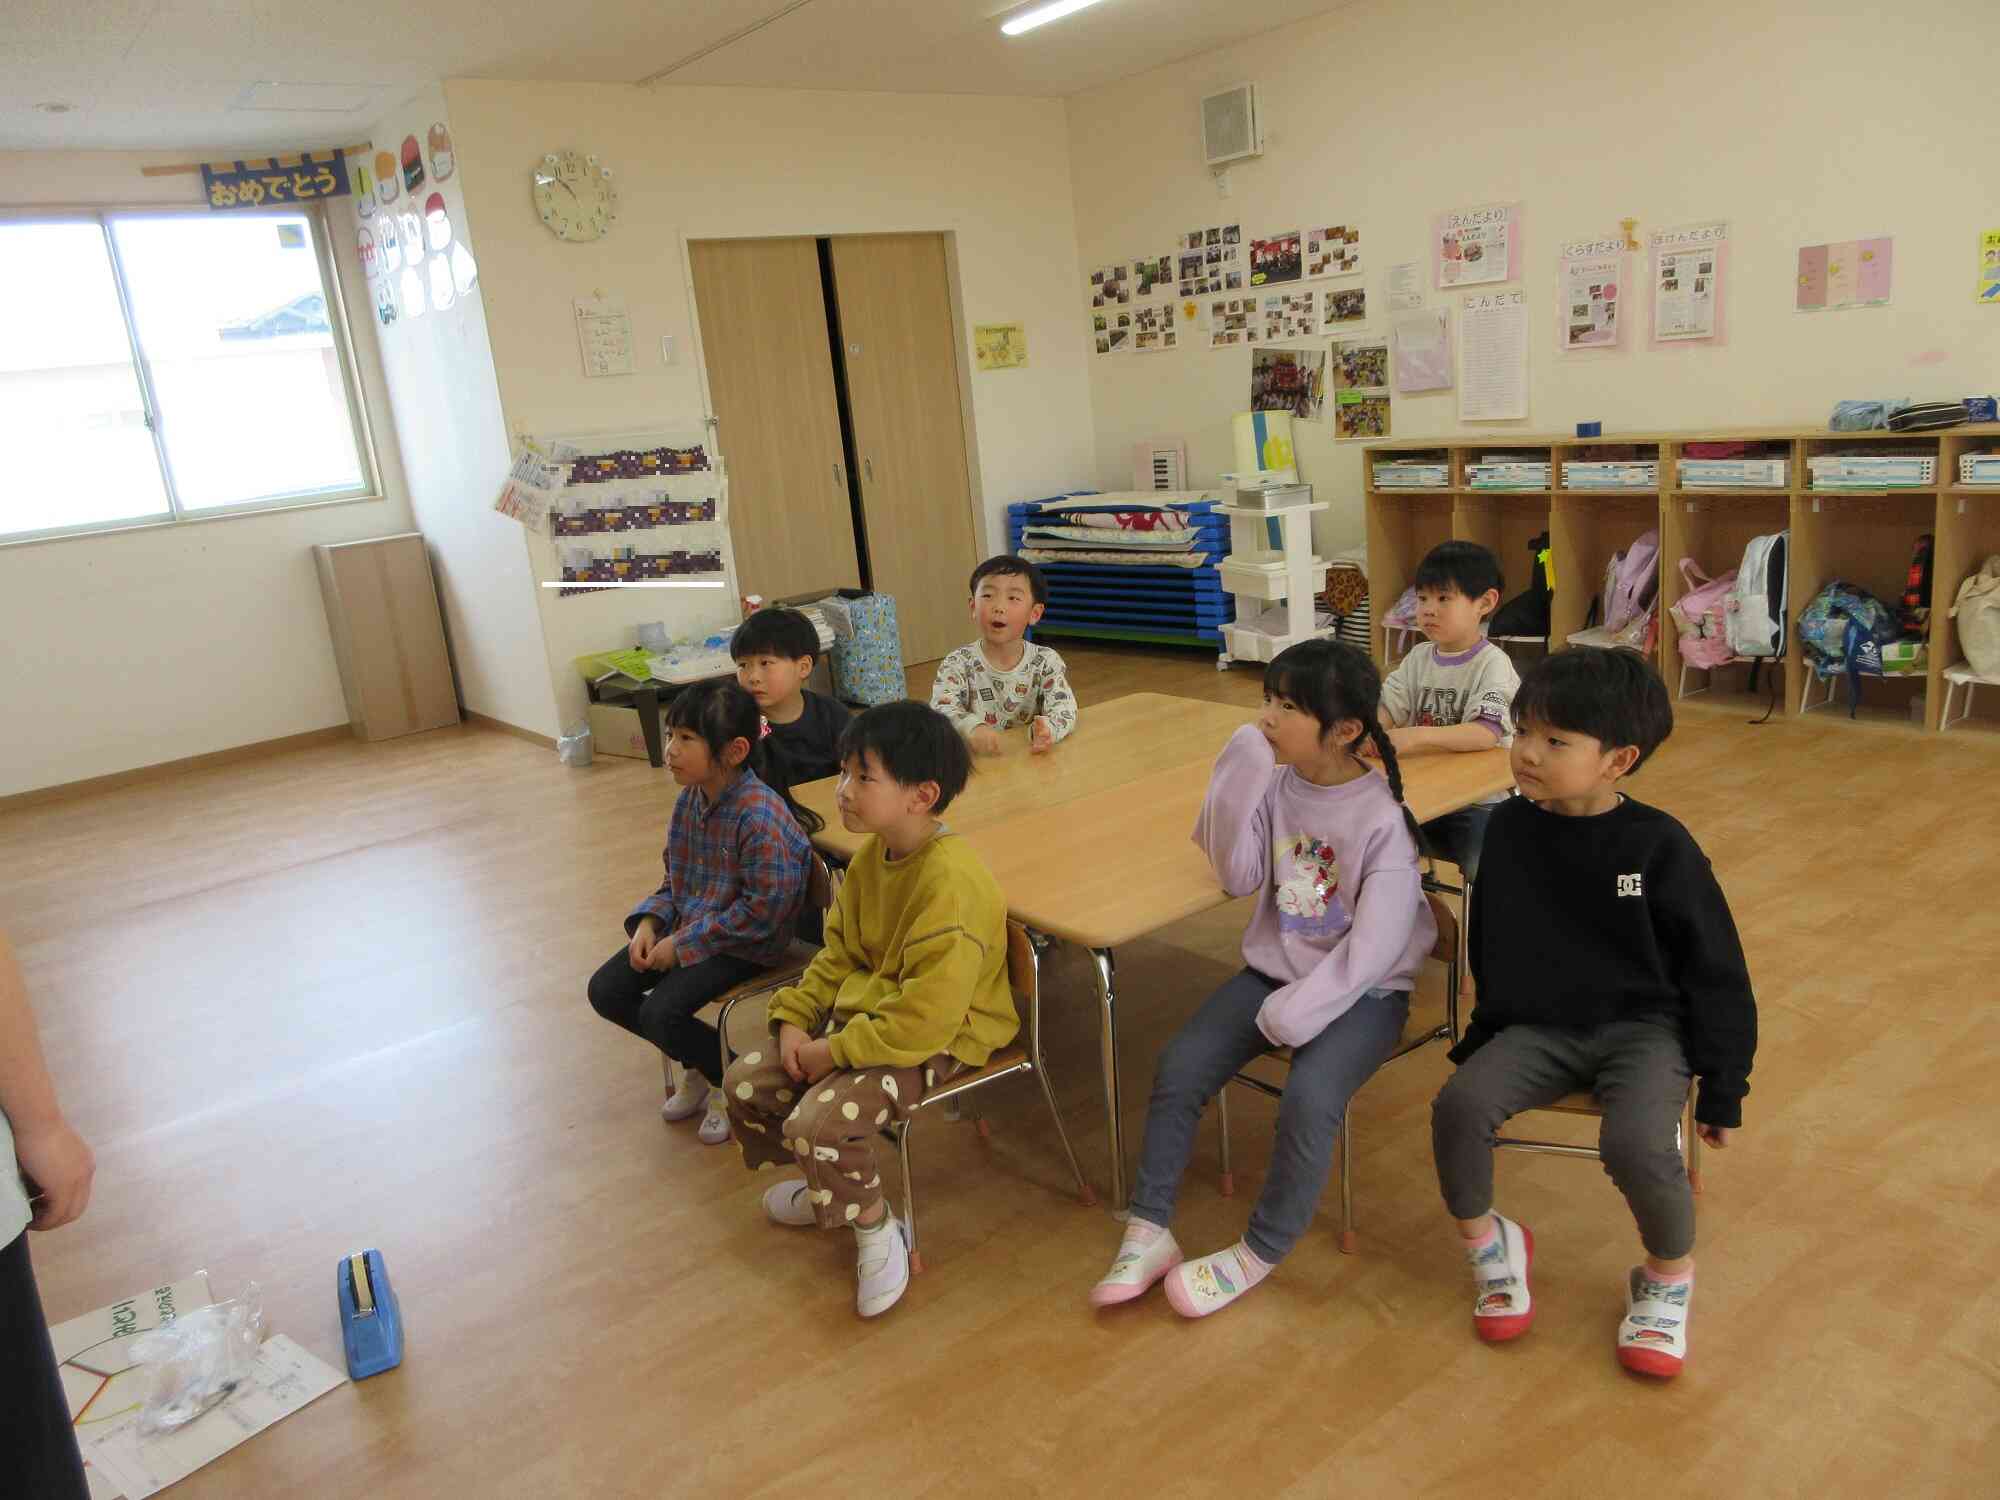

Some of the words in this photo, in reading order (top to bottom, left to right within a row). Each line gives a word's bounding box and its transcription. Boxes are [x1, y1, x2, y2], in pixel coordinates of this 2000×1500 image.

[210, 167, 337, 206] おめでとう
[1450, 209, 1504, 226] えんだより
[1565, 239, 1625, 257] くらすだより
[1465, 291, 1520, 309] こんだて
